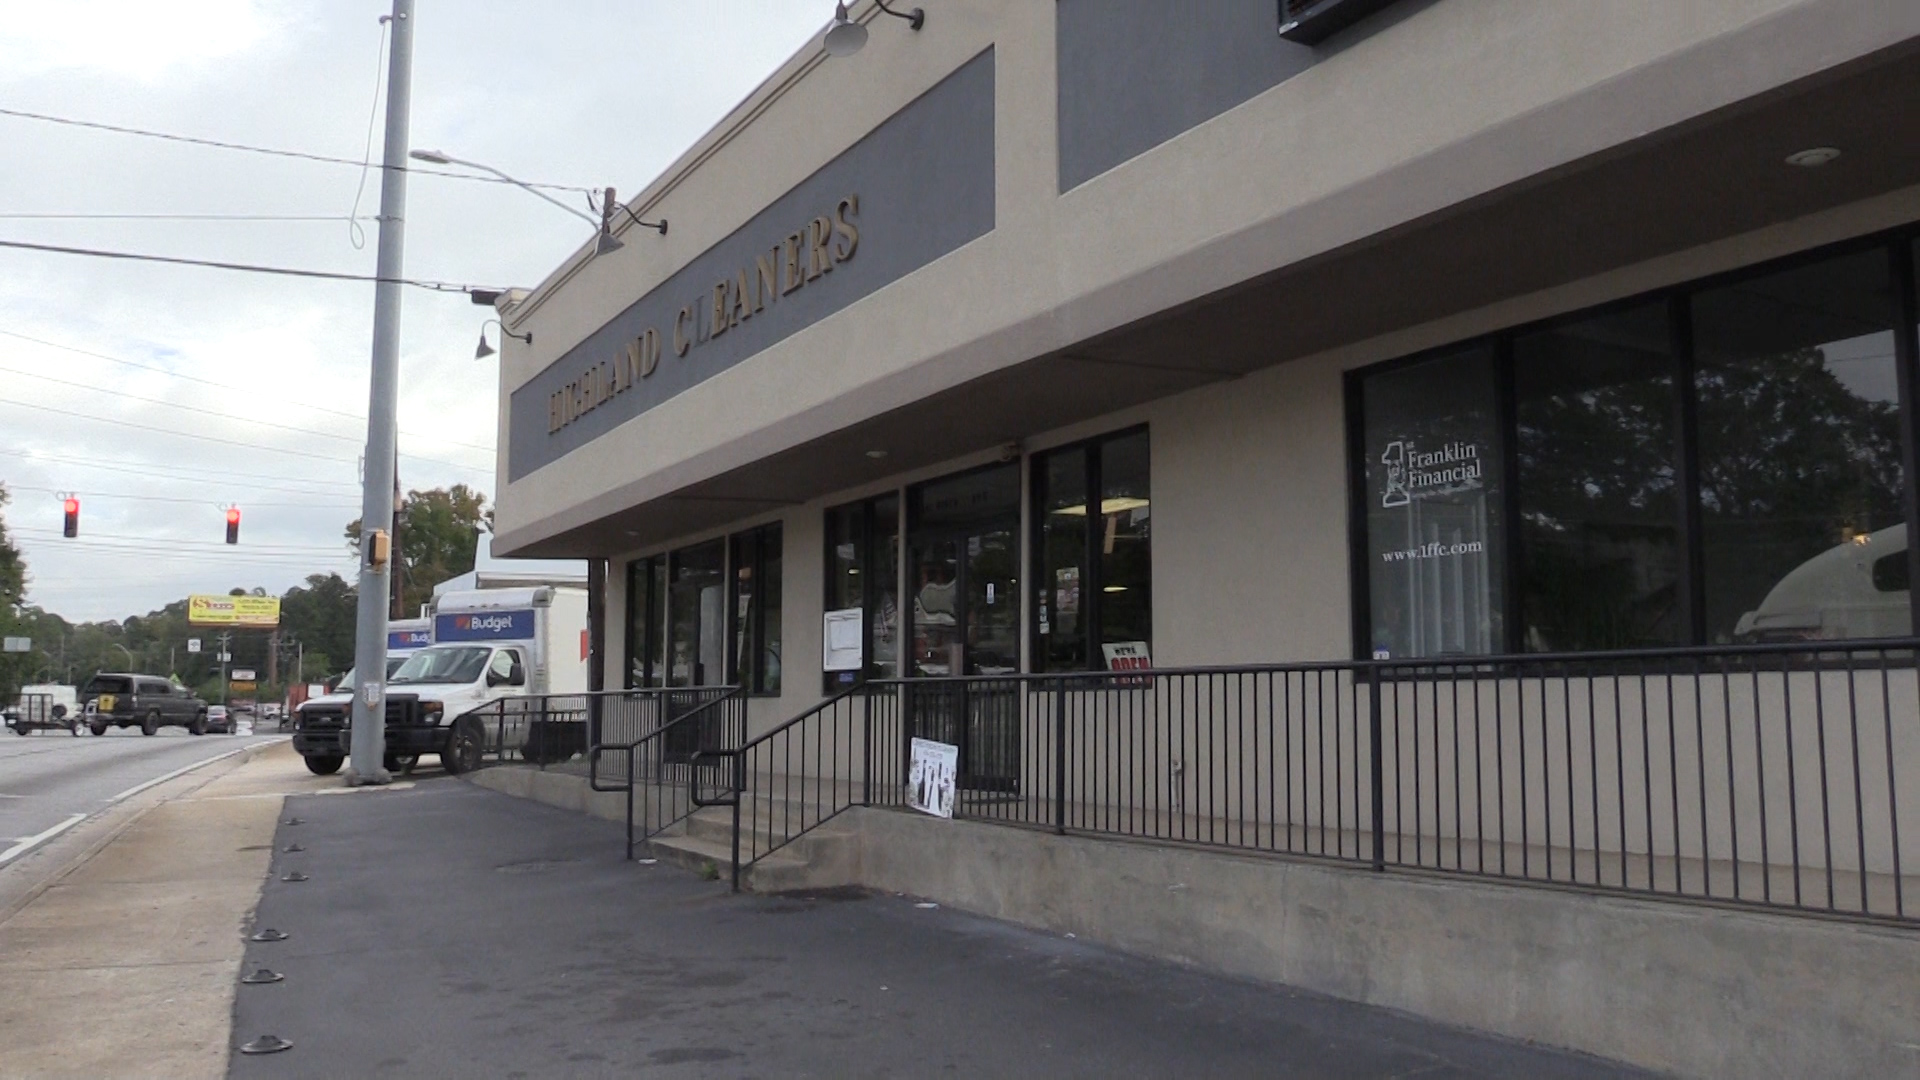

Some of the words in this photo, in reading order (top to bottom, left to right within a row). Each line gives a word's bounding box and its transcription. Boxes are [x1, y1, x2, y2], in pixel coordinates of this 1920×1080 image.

[548, 328, 661, 435] HIGHLAND
[673, 194, 859, 357] CLEANERS
[1408, 442, 1477, 468] Franklin
[1408, 458, 1482, 488] Financial
[1382, 540, 1482, 562] www.1ffc.com
[471, 615, 513, 632] Budget
